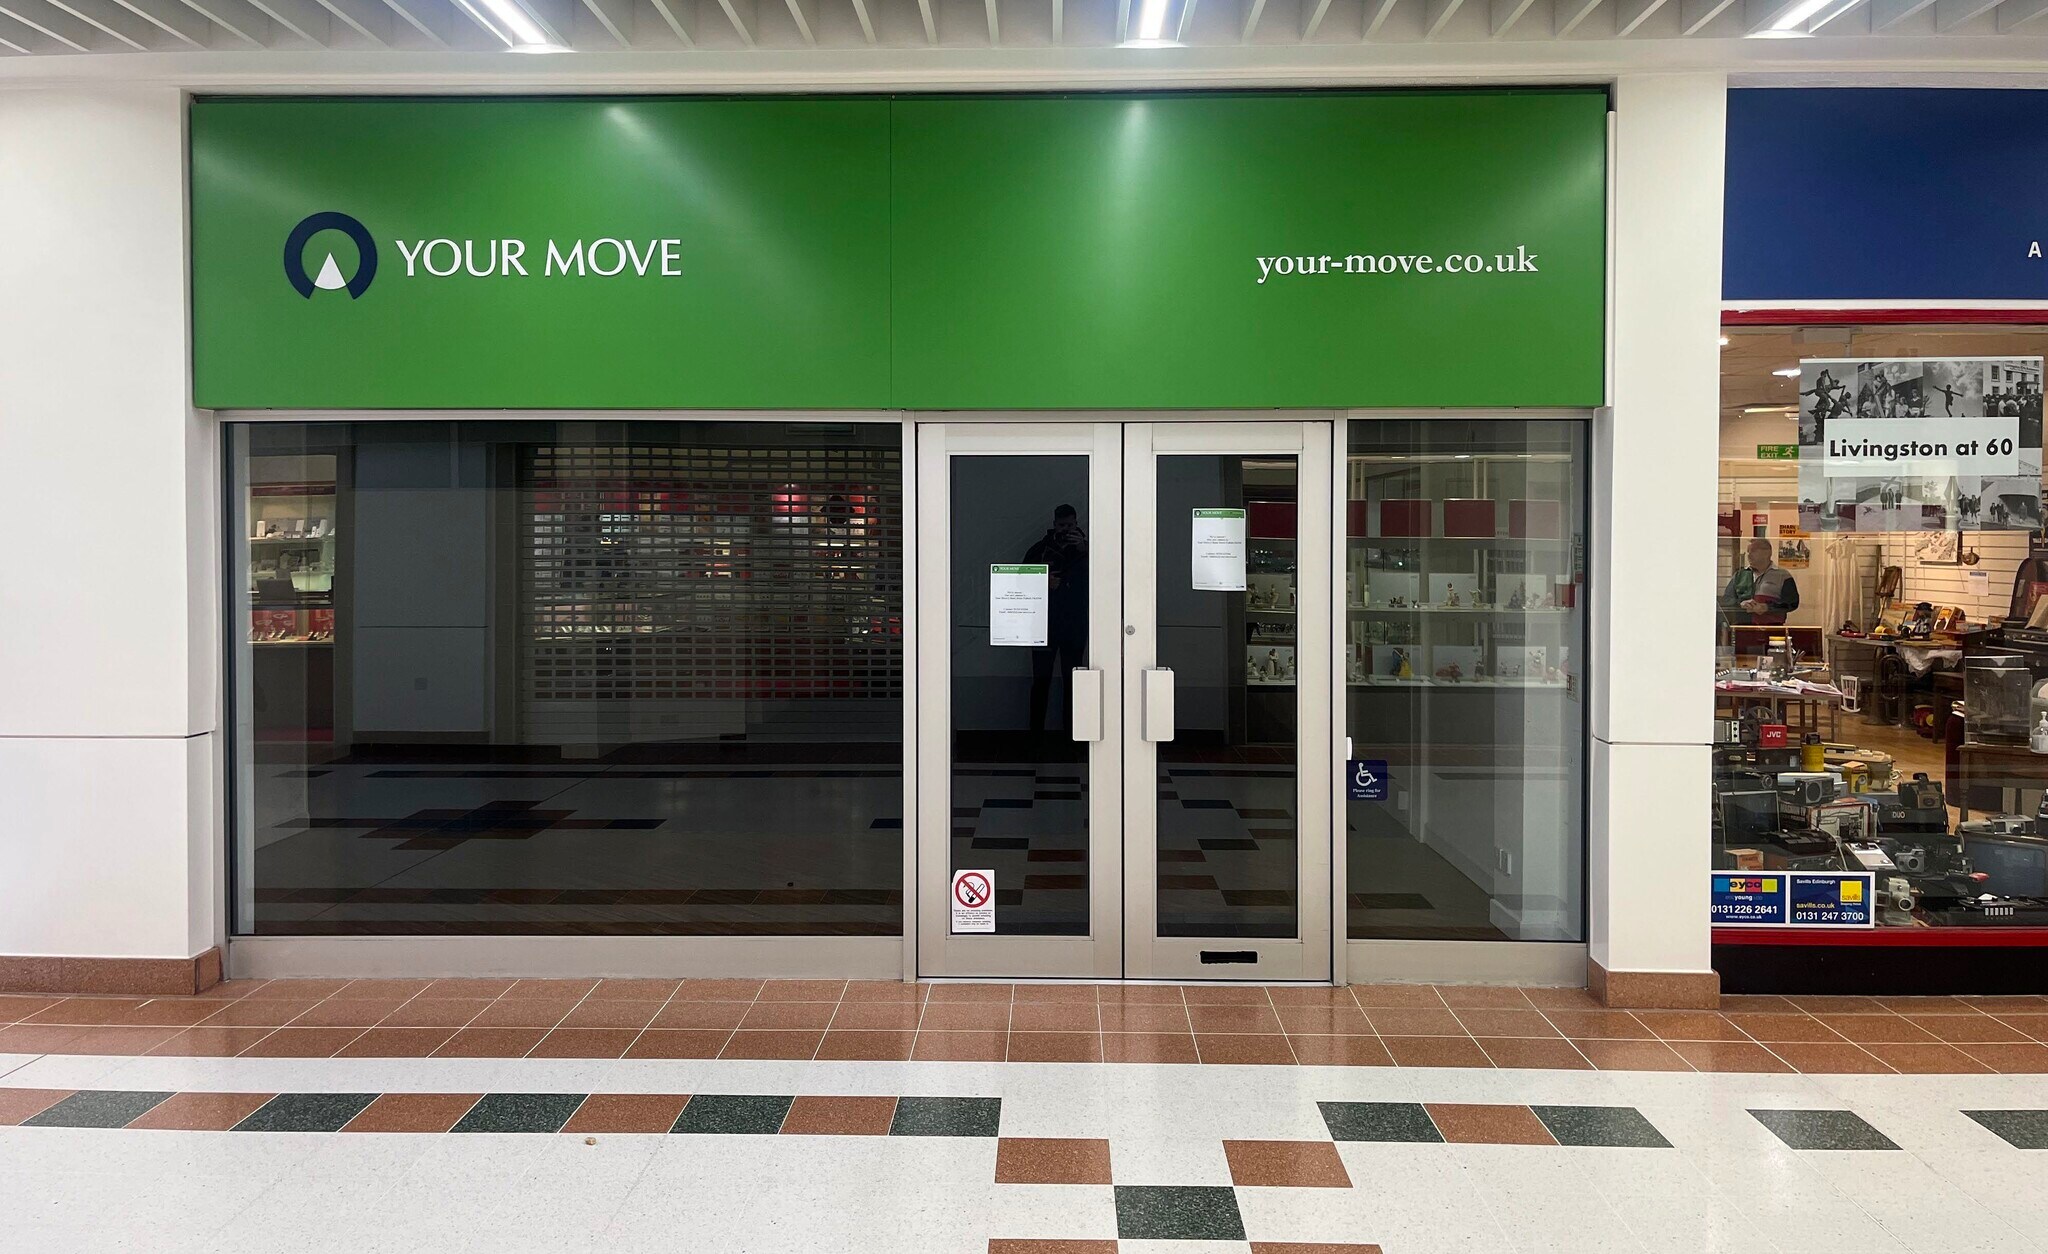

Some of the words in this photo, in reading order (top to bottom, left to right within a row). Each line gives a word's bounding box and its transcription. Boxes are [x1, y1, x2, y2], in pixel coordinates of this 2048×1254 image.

[396, 238, 529, 277] YOUR
[544, 238, 682, 277] MOVE
[2028, 241, 2042, 258] A
[1256, 245, 1539, 284] your-move.co.uk
[1830, 438, 1948, 461] Livingston
[1955, 440, 1979, 456] at
[1986, 438, 2013, 456] 60
[1730, 881, 1761, 889] eyco
[1711, 905, 1733, 913] 0131
[1734, 905, 1752, 913] 226
[1754, 905, 1778, 914] 2641
[1796, 911, 1818, 920] 0131
[1821, 911, 1839, 920] 247
[1841, 912, 1864, 921] 3700
